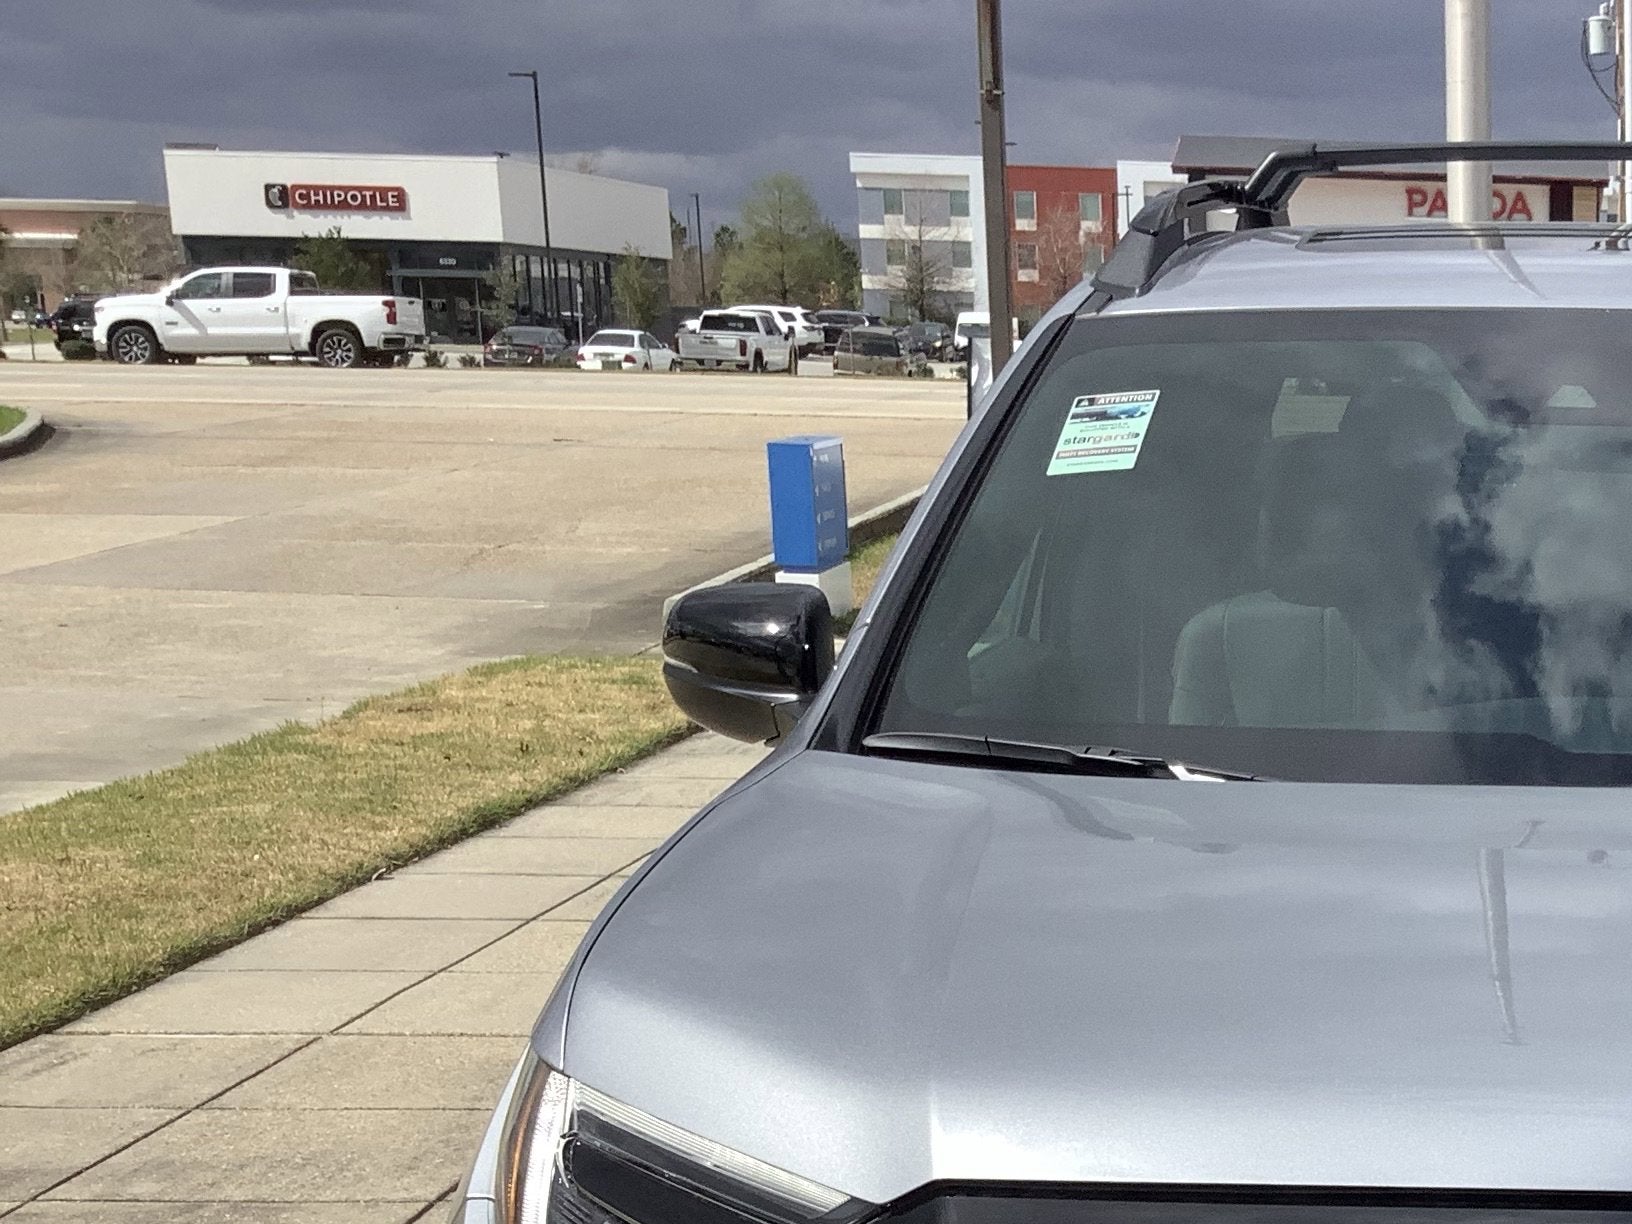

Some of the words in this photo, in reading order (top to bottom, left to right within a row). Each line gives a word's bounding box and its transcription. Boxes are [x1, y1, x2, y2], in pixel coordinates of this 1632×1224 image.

[294, 189, 400, 207] CHIPOTLE
[1405, 184, 1533, 221] PADA
[1097, 394, 1153, 405] ATTENTION
